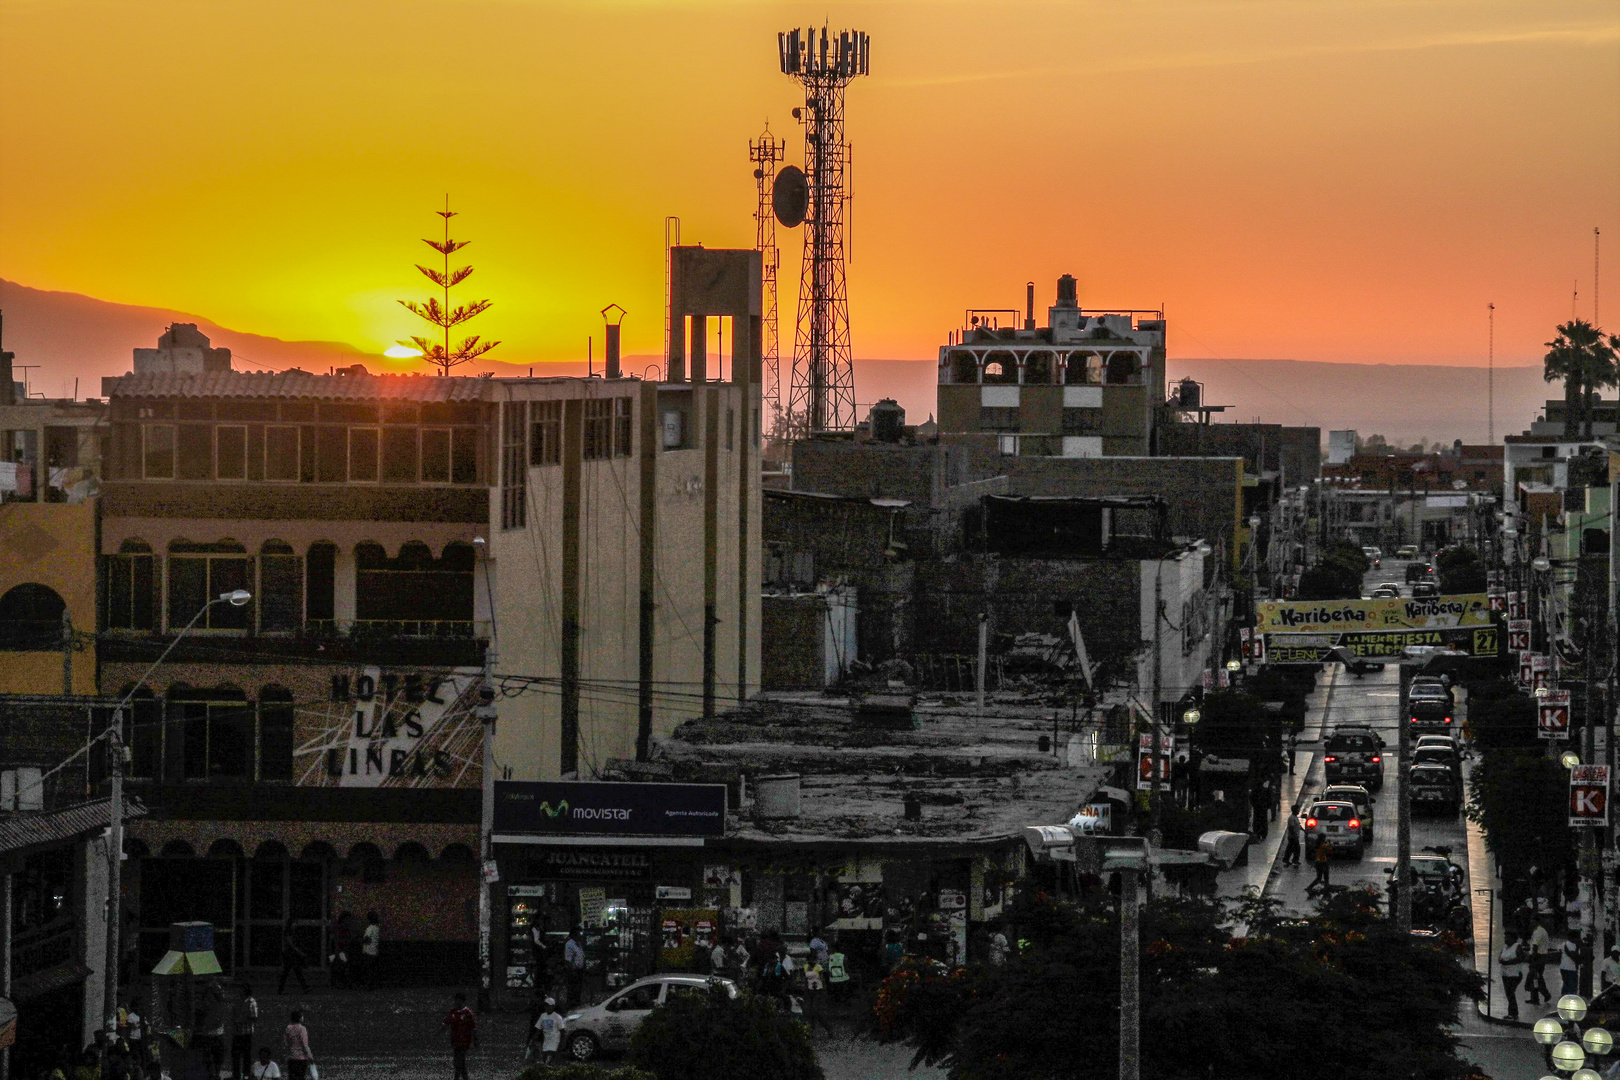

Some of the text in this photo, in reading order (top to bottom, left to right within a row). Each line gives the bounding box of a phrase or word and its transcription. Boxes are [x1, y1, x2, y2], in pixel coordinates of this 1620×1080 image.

[1280, 605, 1365, 627] Karibeña
[1393, 632, 1443, 645] FIESTA
[1477, 633, 1497, 651] 27
[1512, 633, 1525, 647] K
[331, 674, 445, 705] HOTEL
[355, 710, 424, 739] LAS
[1545, 709, 1562, 727] K
[327, 747, 452, 778] LINEAS
[1577, 790, 1599, 813] K
[572, 807, 632, 820] movistar
